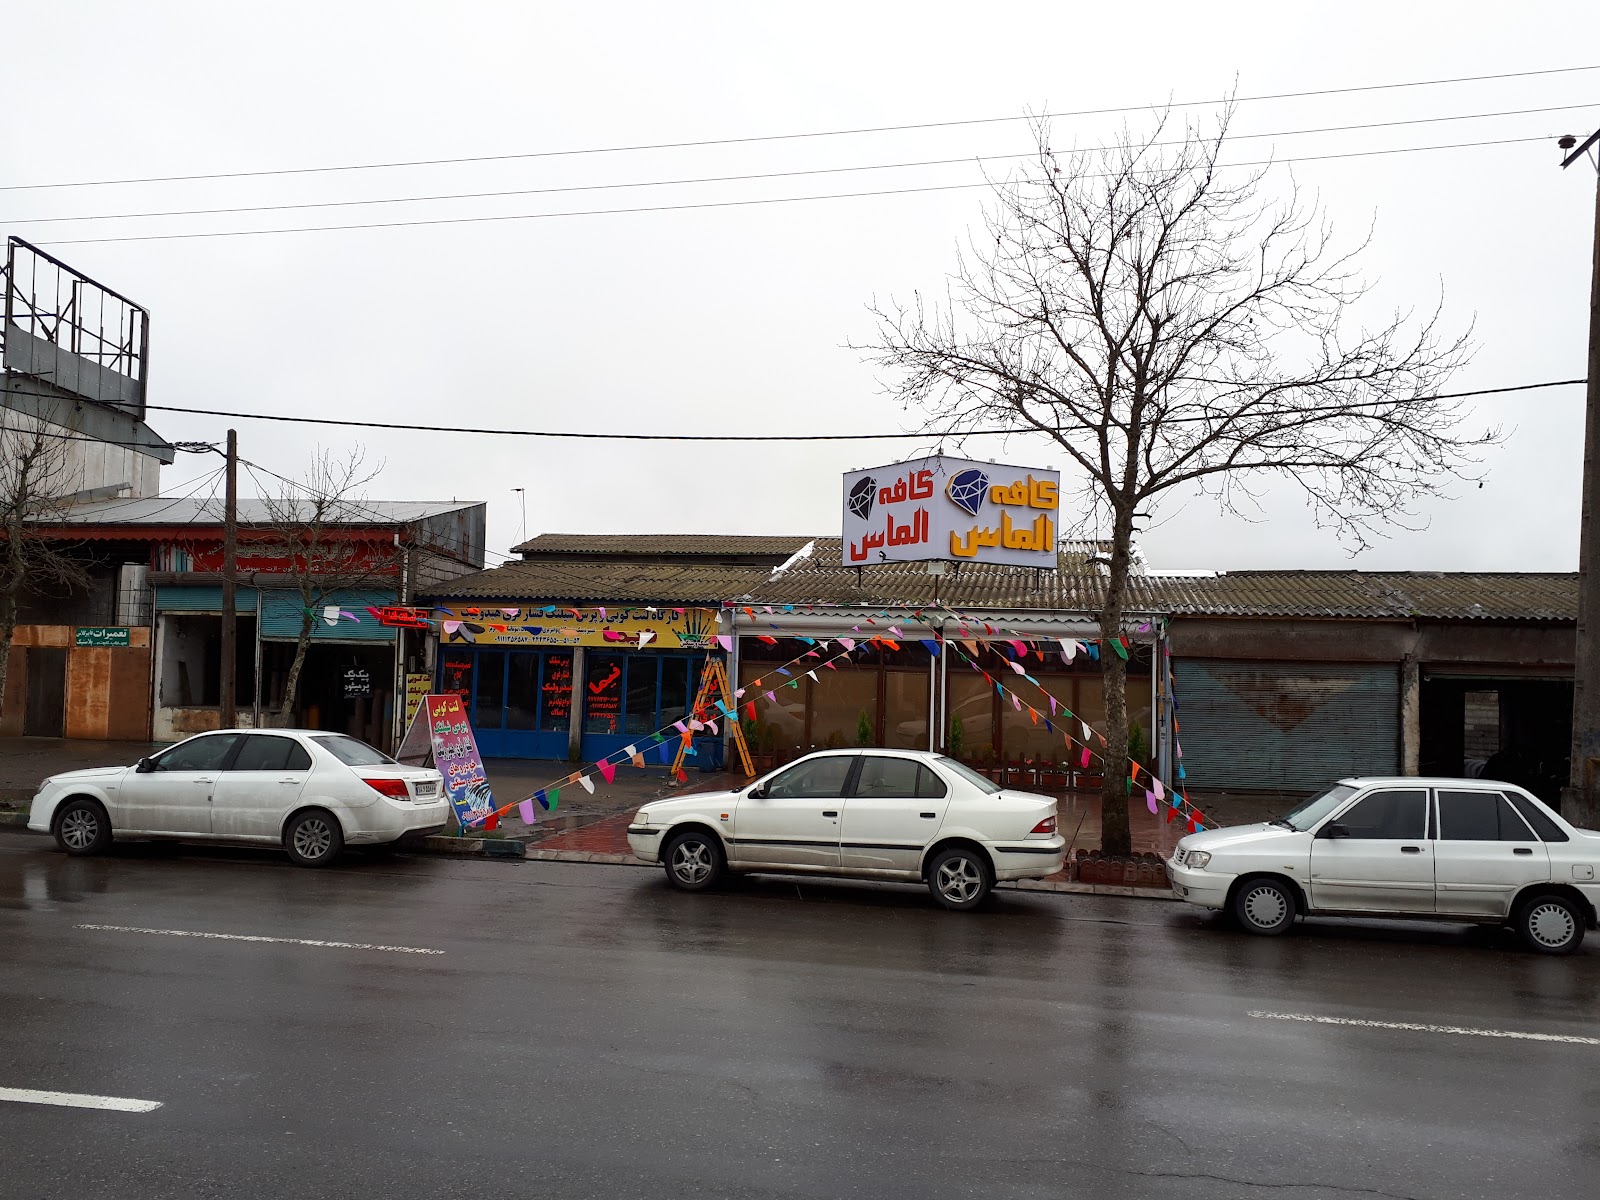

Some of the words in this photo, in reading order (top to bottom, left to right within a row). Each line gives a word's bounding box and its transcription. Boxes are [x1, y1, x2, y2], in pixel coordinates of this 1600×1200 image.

[878, 468, 934, 506] کافه
[990, 473, 1060, 510] کافه
[850, 504, 929, 562] الماس
[950, 509, 1054, 559] الماس
[576, 610, 598, 623] پرس
[606, 609, 630, 624] کوبی
[632, 609, 649, 621] لنت
[651, 608, 680, 624] کارگاه
[93, 628, 128, 640] تعمیرات
[355, 669, 370, 683] پیک
[432, 700, 447, 717] کوبی
[448, 699, 460, 713] لنت
[448, 759, 477, 776] خودروهای
